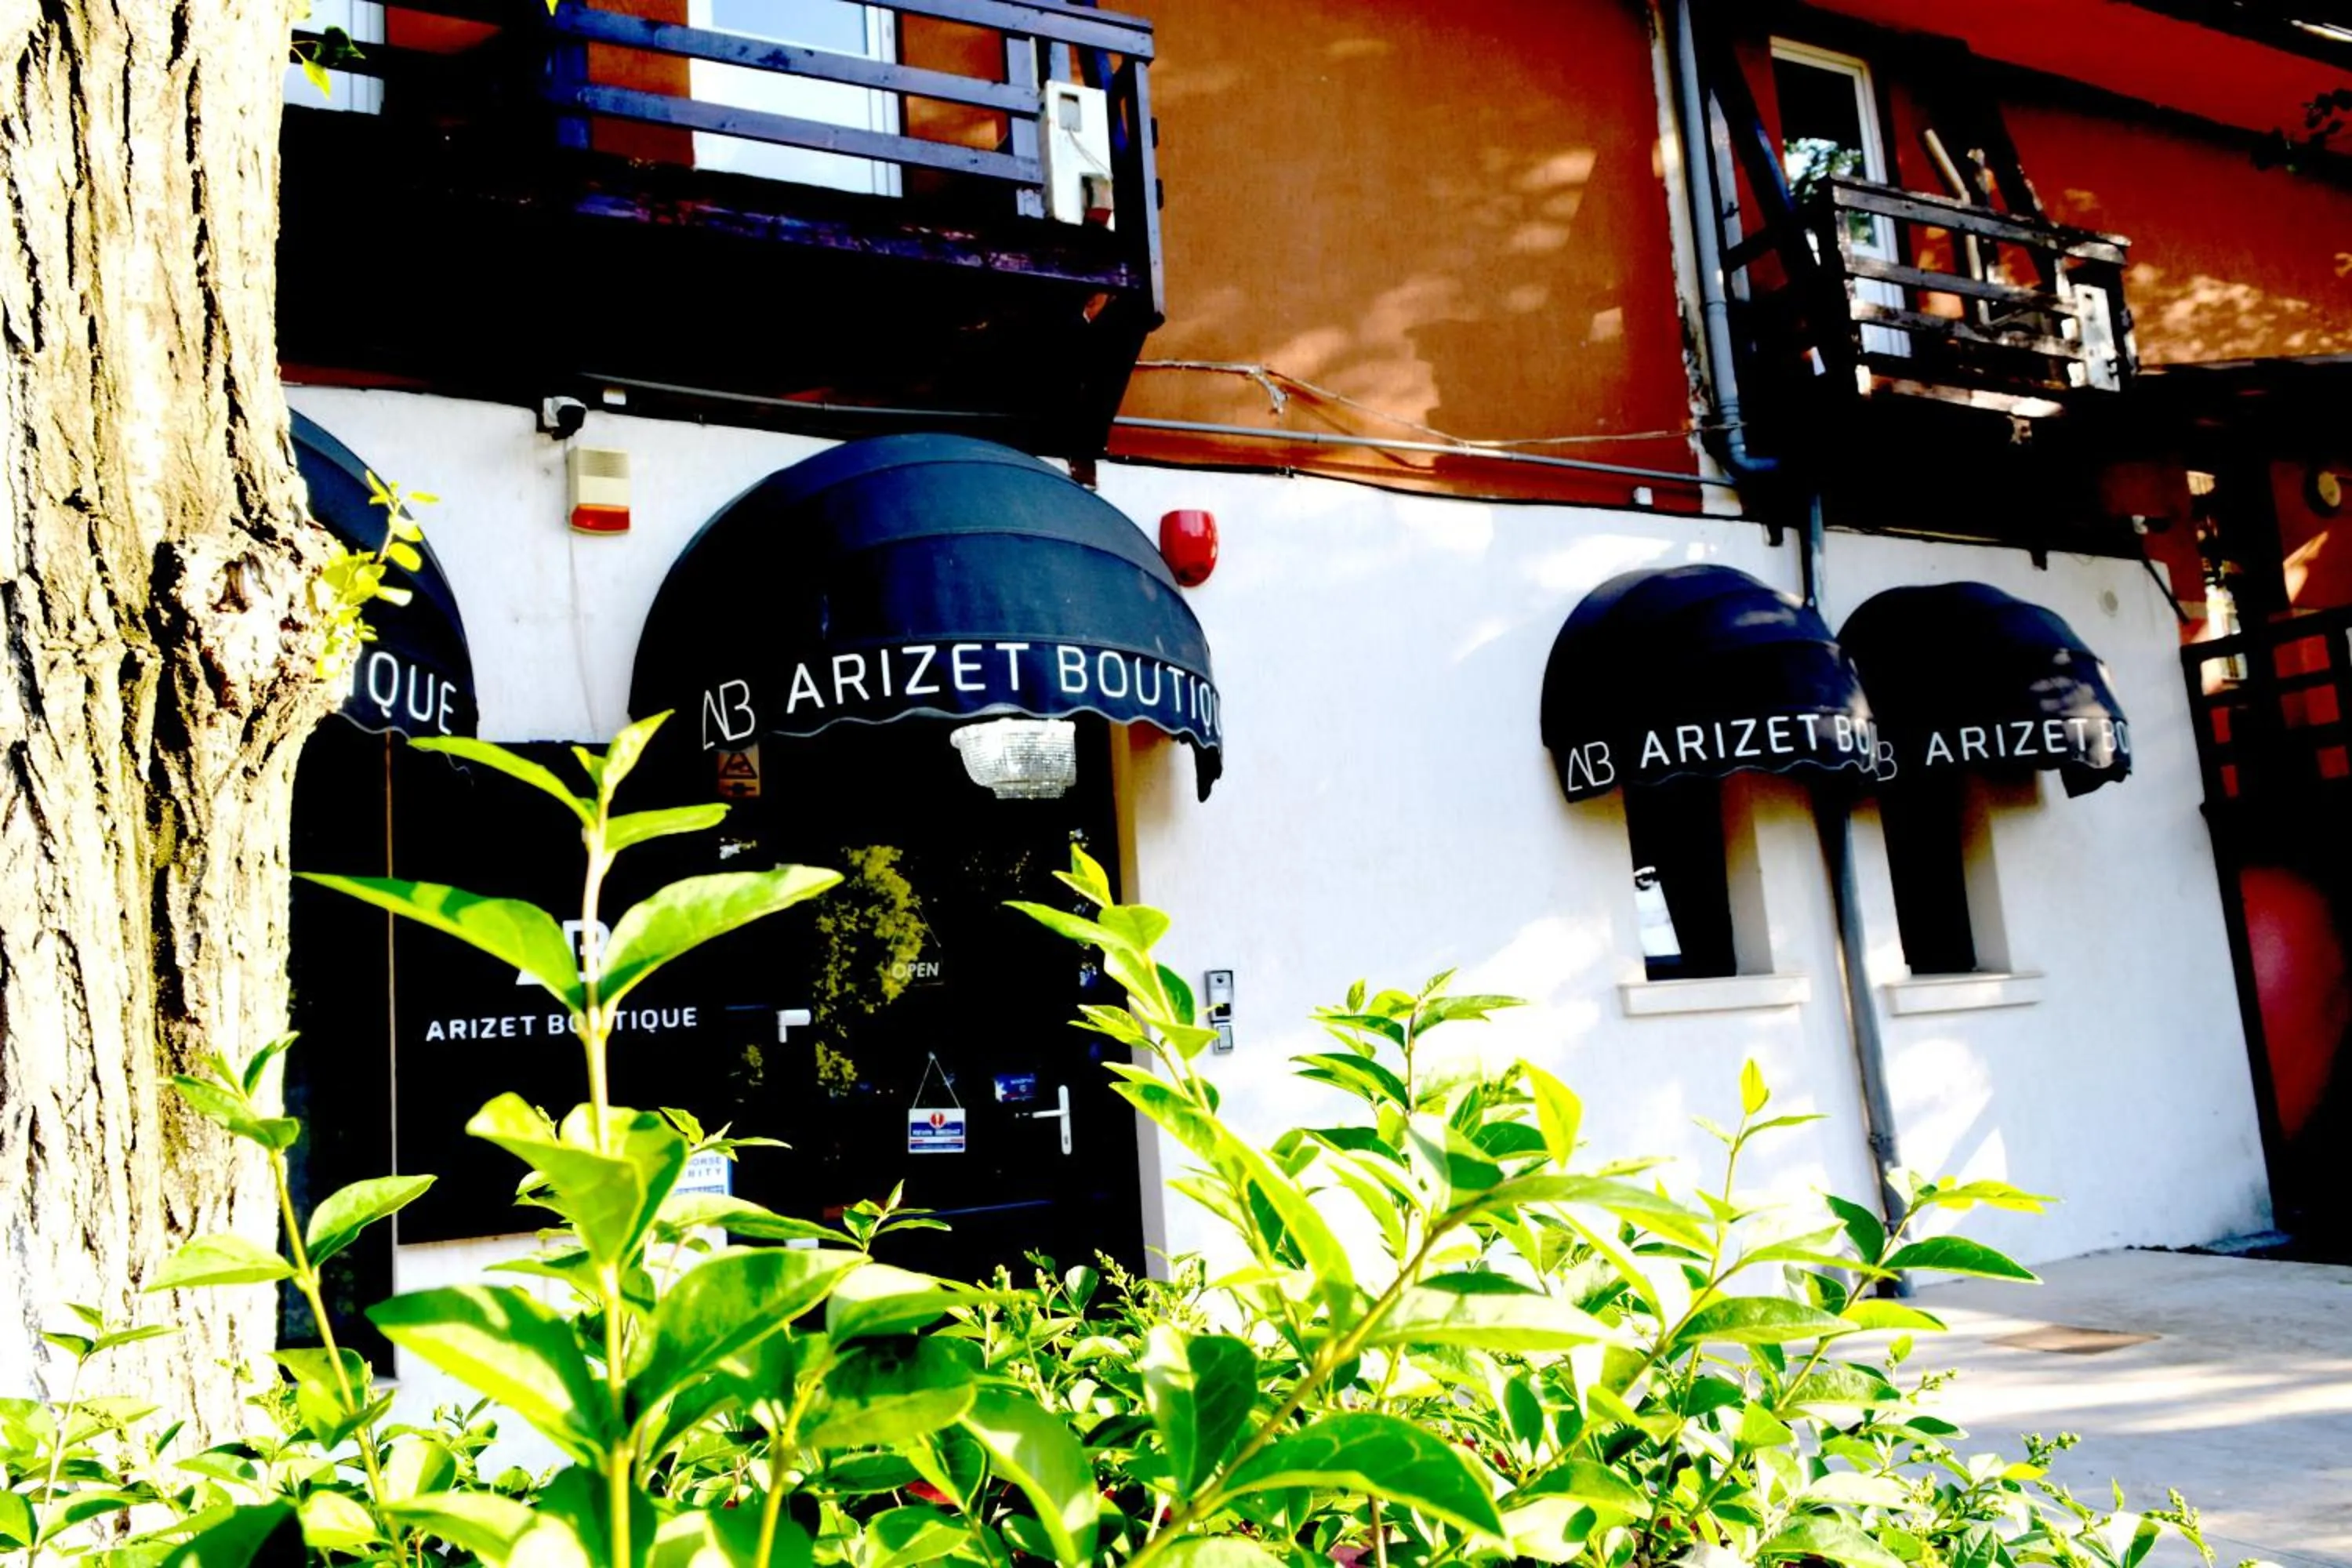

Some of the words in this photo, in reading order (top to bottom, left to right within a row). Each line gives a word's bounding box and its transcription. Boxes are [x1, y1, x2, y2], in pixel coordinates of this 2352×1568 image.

[347, 652, 457, 735] QUE
[786, 642, 1030, 714] ARIZET
[1640, 713, 1820, 769] ARIZET
[1834, 714, 1877, 757] BO
[1877, 740, 1898, 782] B
[1926, 717, 2089, 766] ARIZET
[891, 961, 940, 980] OPEN
[426, 1016, 537, 1042] ARIZET
[548, 1007, 698, 1035] BOTIQUE
